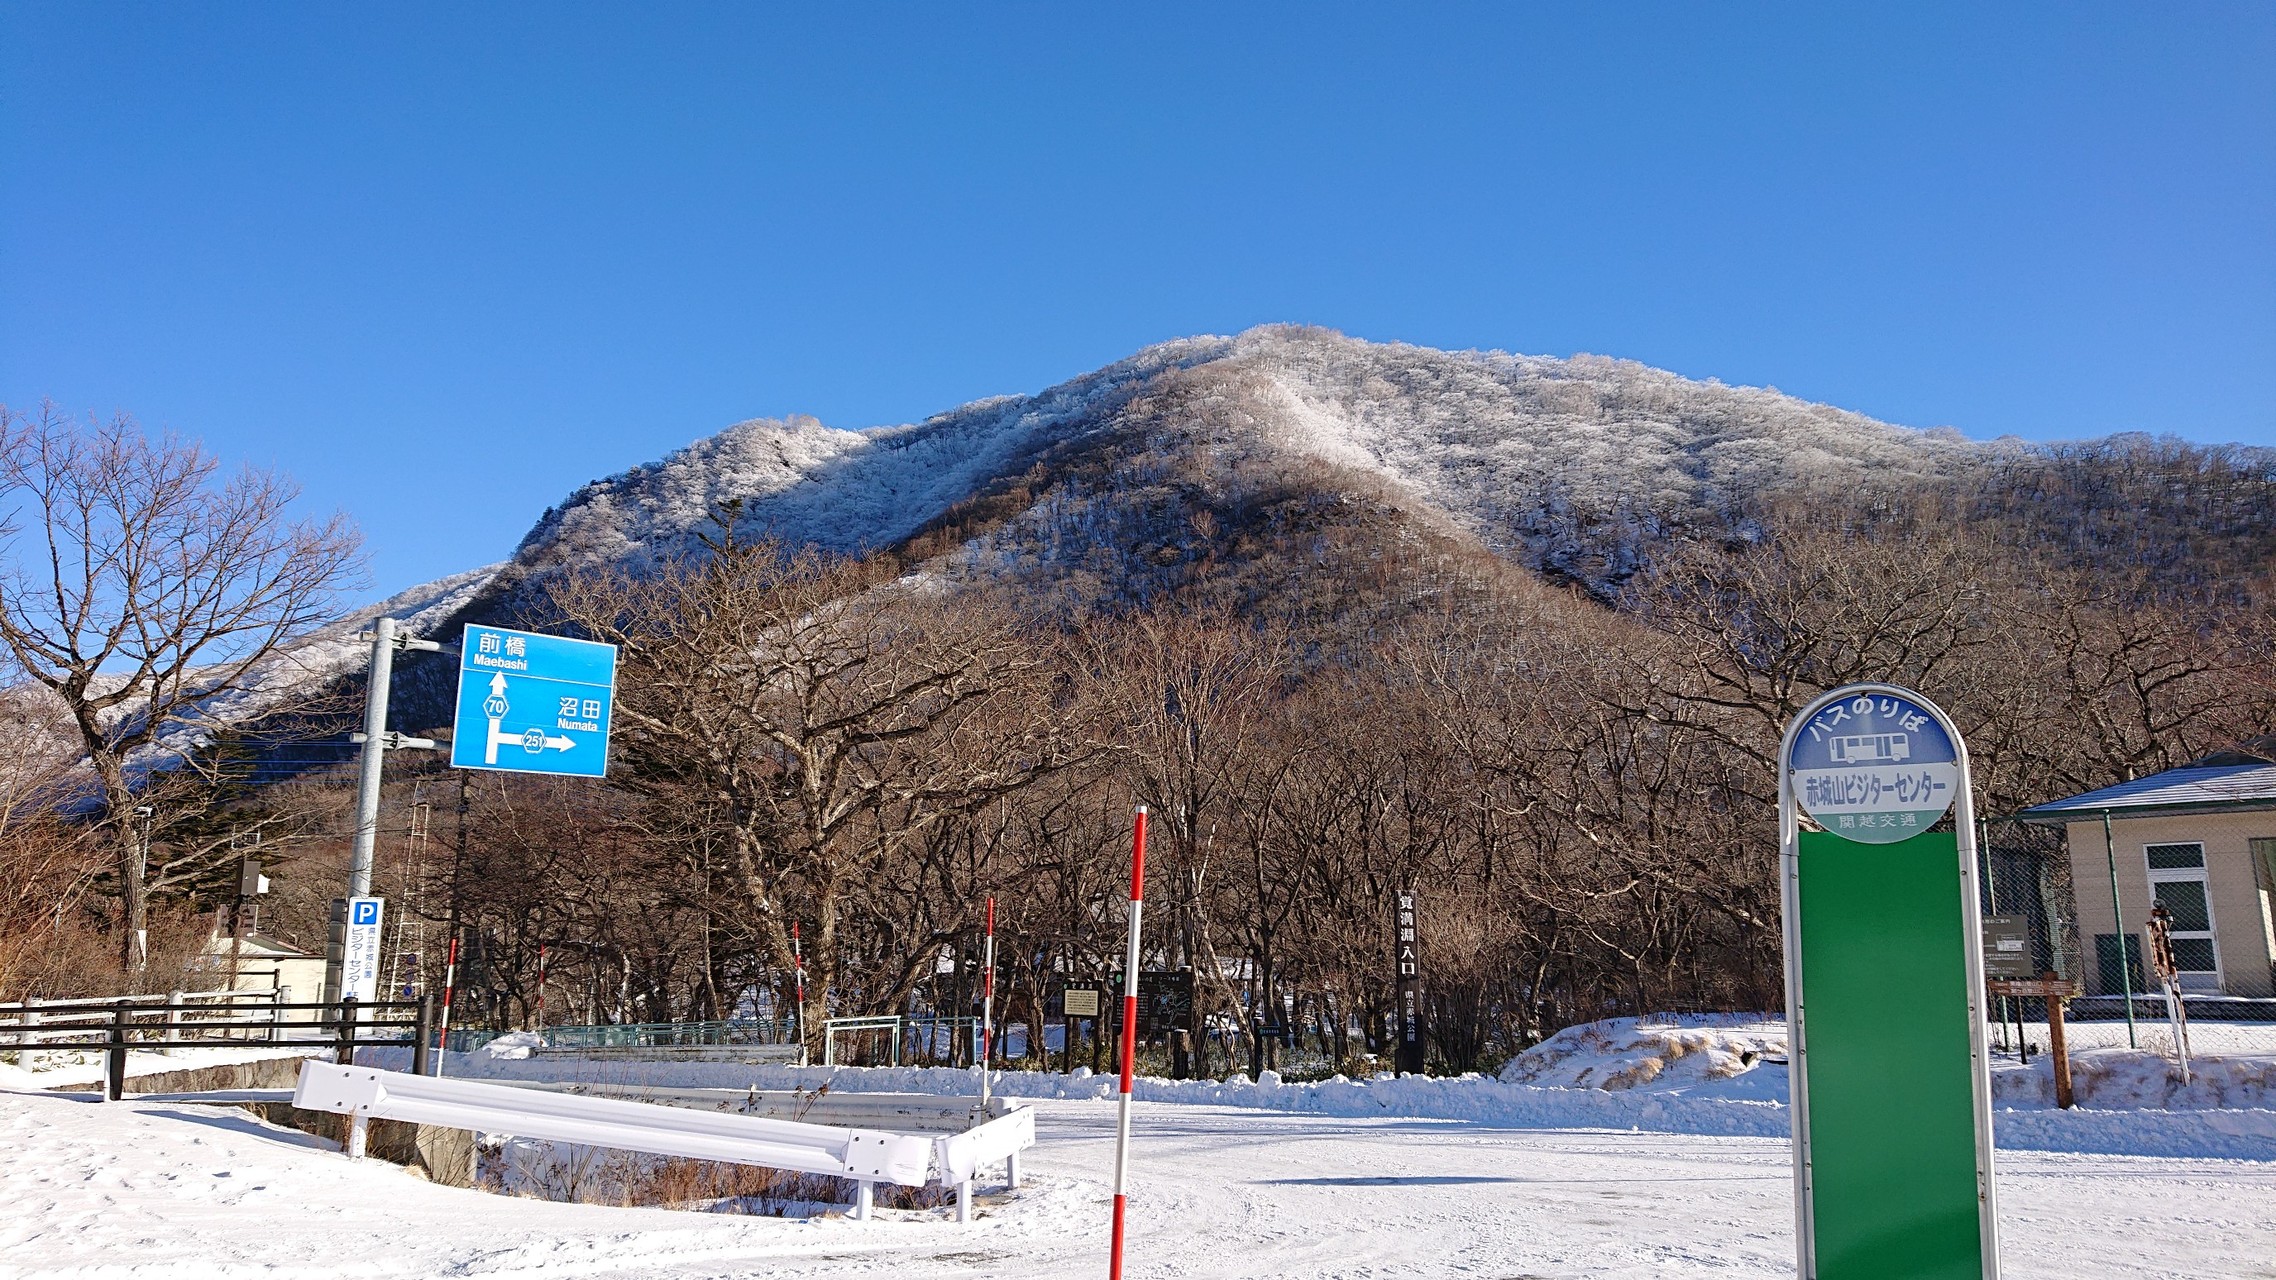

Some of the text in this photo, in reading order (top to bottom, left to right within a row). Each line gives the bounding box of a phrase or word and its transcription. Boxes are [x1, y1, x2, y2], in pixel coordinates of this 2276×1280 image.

[479, 633, 526, 657] 前橋
[473, 653, 528, 671] Maebashi
[488, 699, 504, 713] 70
[557, 696, 600, 719] 沼田
[557, 717, 598, 732] Numata
[1809, 698, 1929, 742] バスのりば
[525, 734, 544, 748] 251
[1806, 771, 1946, 807] 赤城山ビジターセンター
[1839, 813, 1918, 829] 関越交通
[358, 904, 375, 923] P
[347, 927, 364, 991] ビジターセンター
[363, 927, 376, 979] 県立赤城公園
